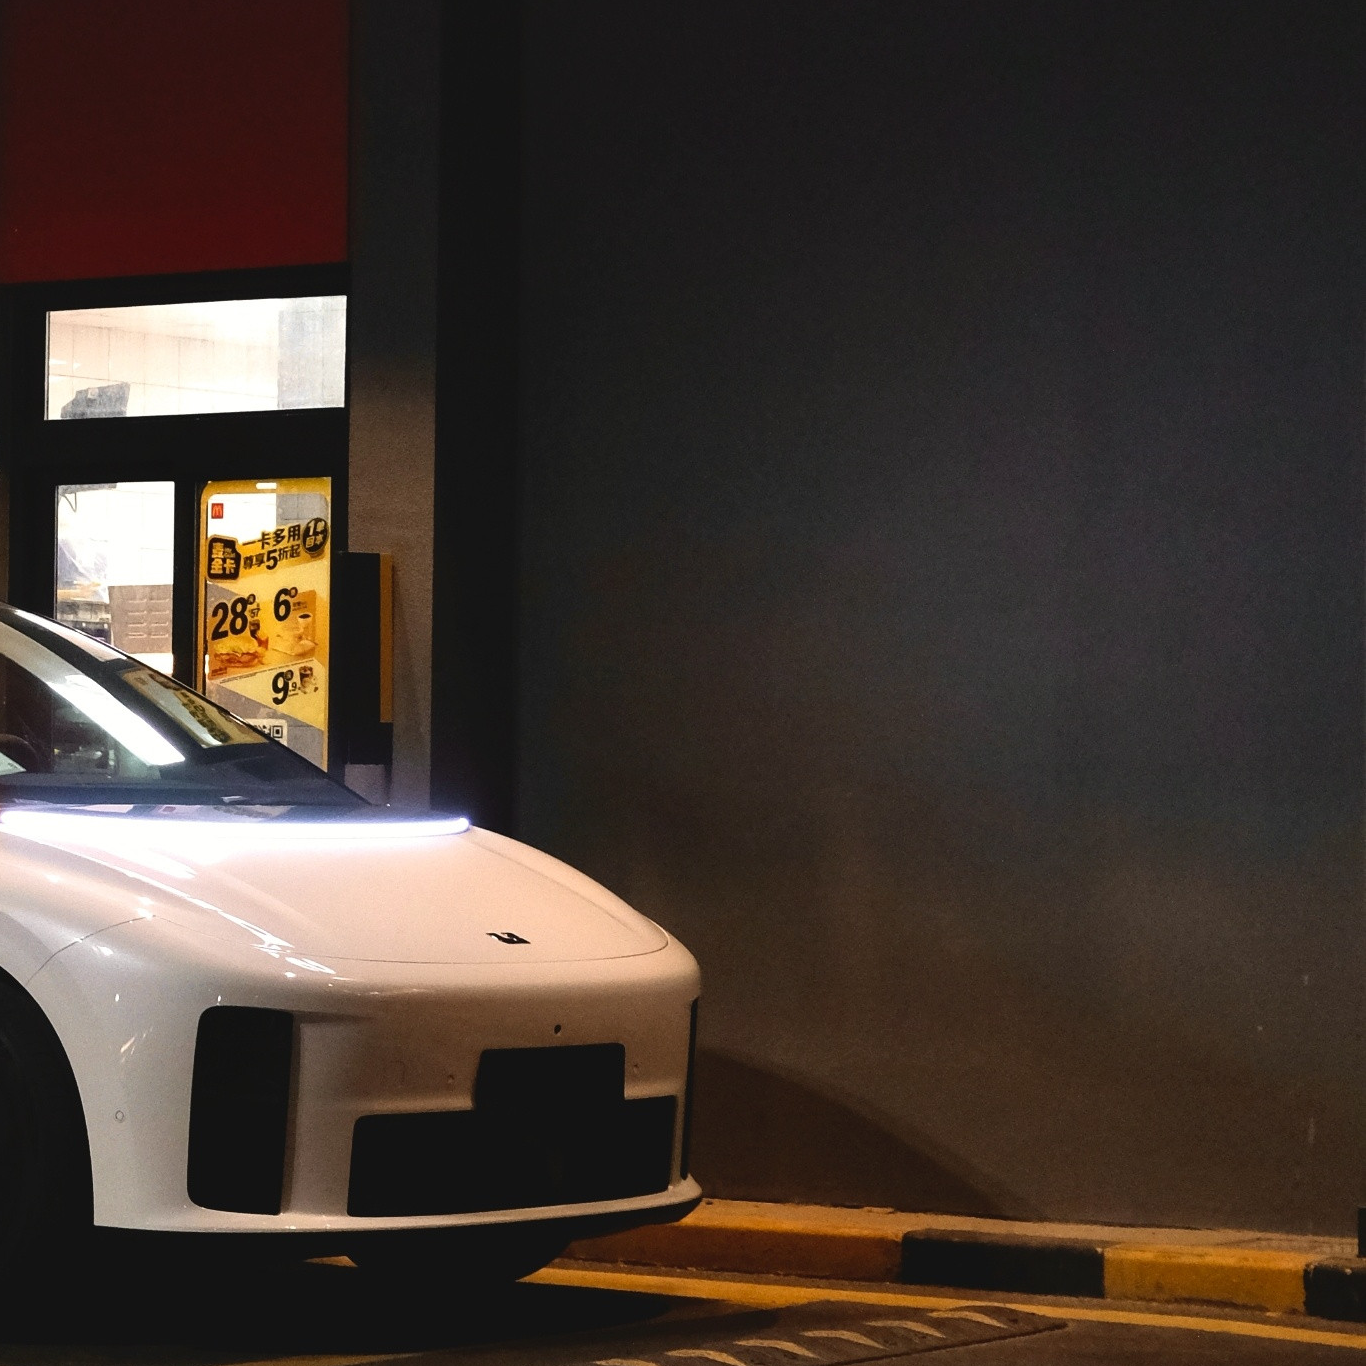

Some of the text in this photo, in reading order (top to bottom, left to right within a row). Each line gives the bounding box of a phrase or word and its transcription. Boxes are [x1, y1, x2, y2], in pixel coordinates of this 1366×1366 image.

[242, 523, 301, 550] 一卡多用
[243, 543, 301, 571] 尊享5折起
[211, 596, 248, 641] 28
[273, 587, 291, 622] 6
